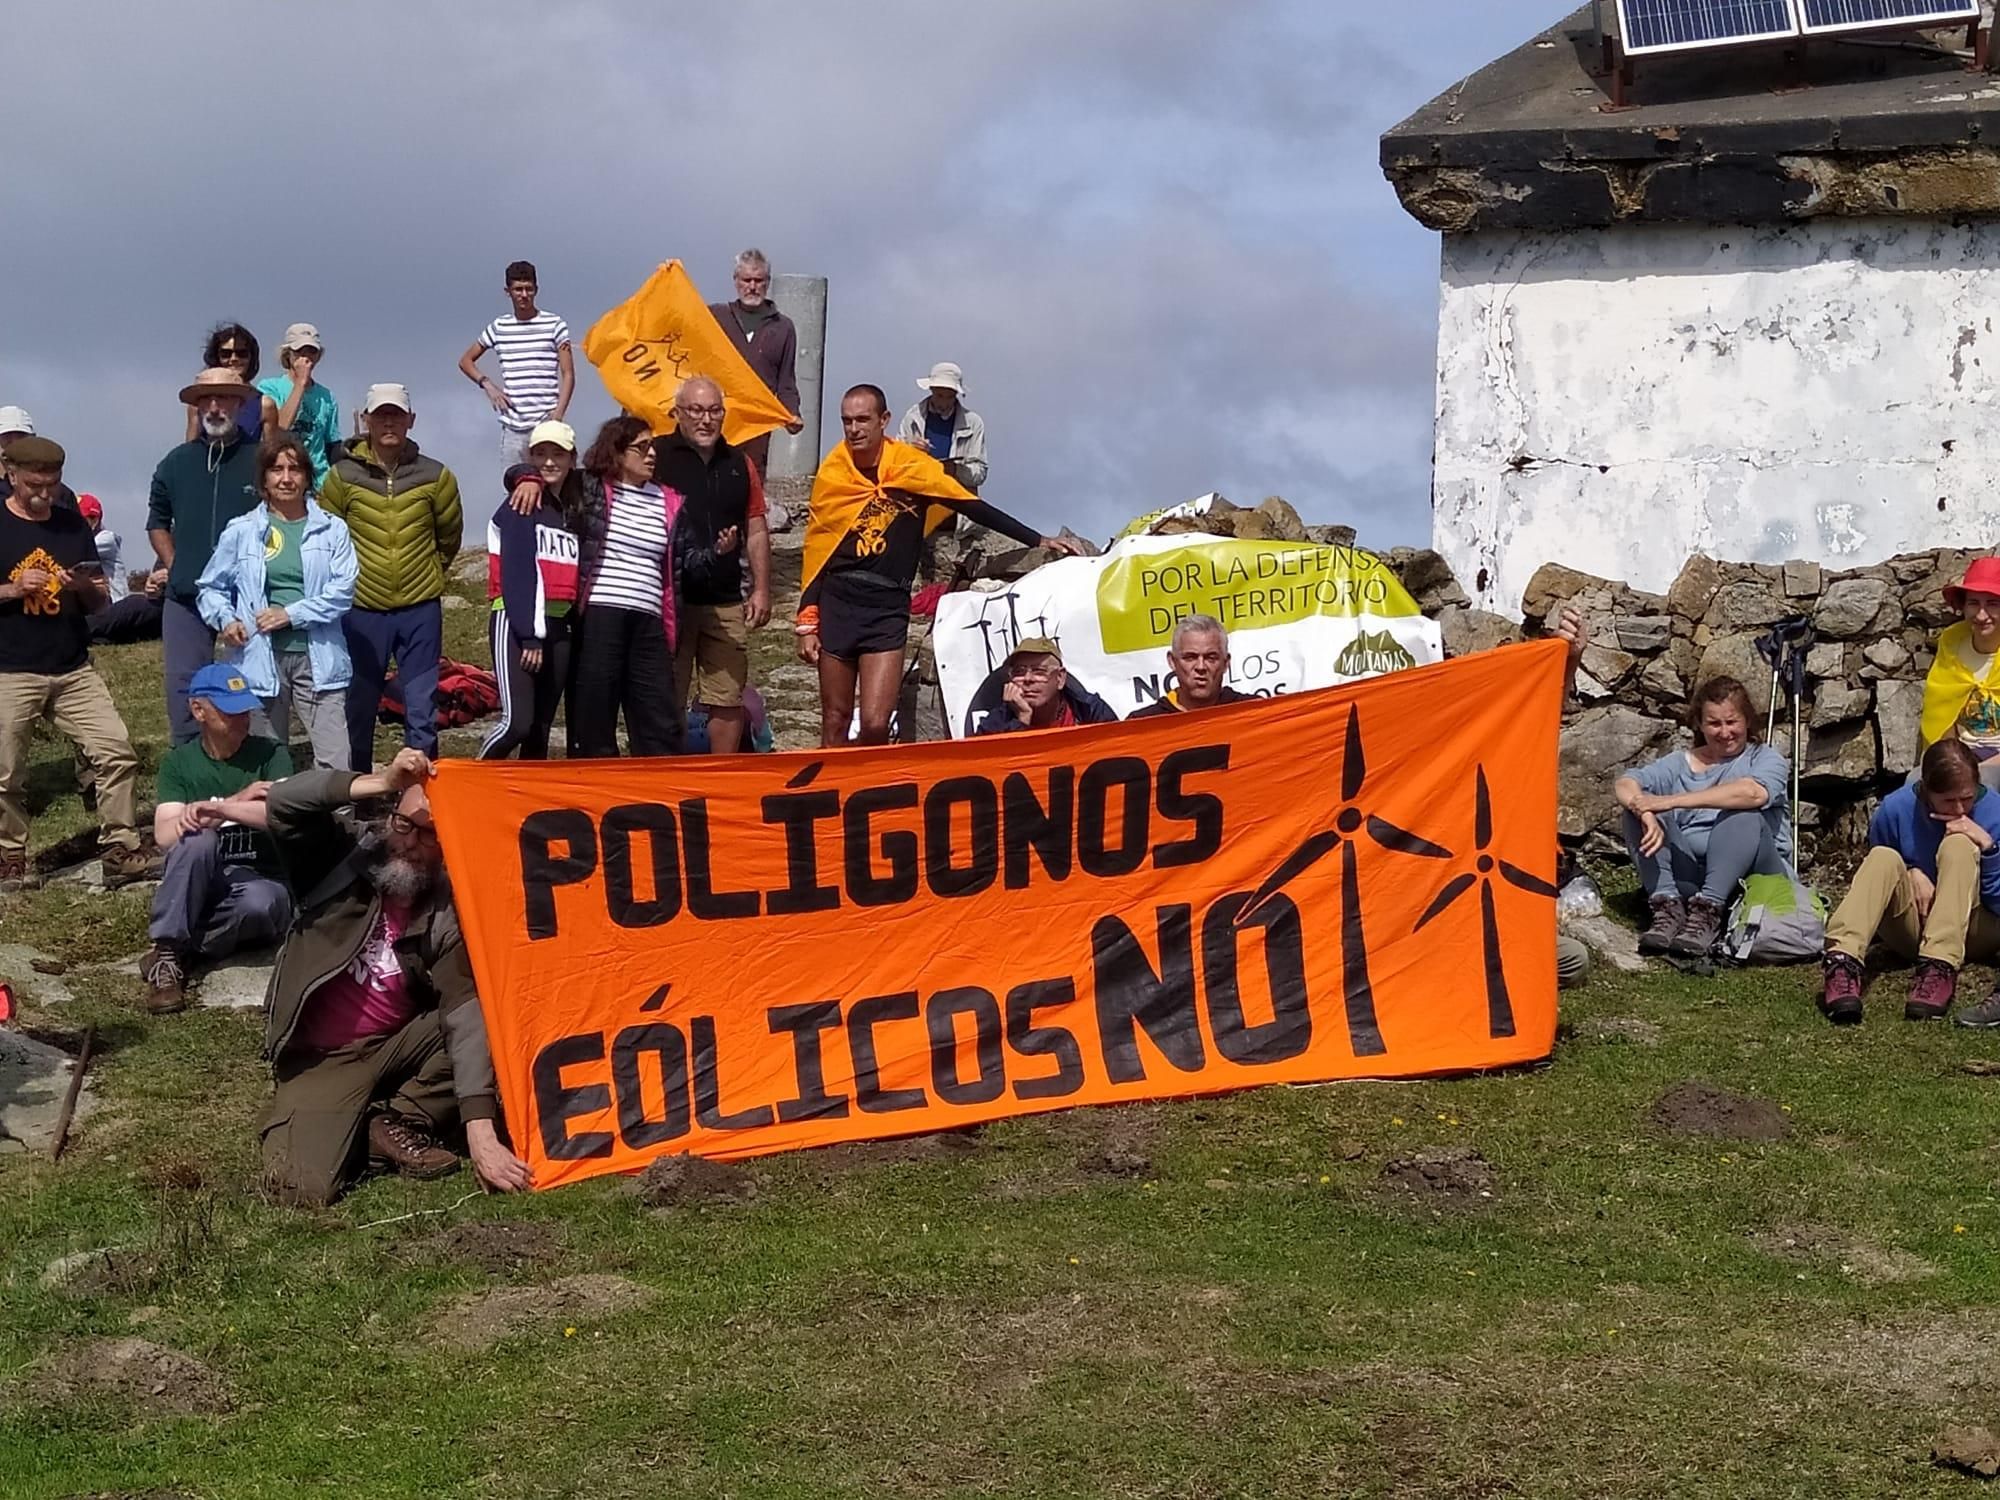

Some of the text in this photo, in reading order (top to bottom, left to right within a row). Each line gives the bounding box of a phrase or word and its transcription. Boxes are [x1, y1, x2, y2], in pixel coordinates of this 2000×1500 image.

[856, 537, 887, 557] NO
[1141, 563, 1204, 597] POR
[1210, 556, 1249, 587] LA
[1211, 578, 1388, 624] TERRITORIO
[1228, 650, 1281, 684] LOS
[519, 744, 1231, 940] POLÍGONOS
[532, 890, 1312, 1161] EÓLICOS NO
